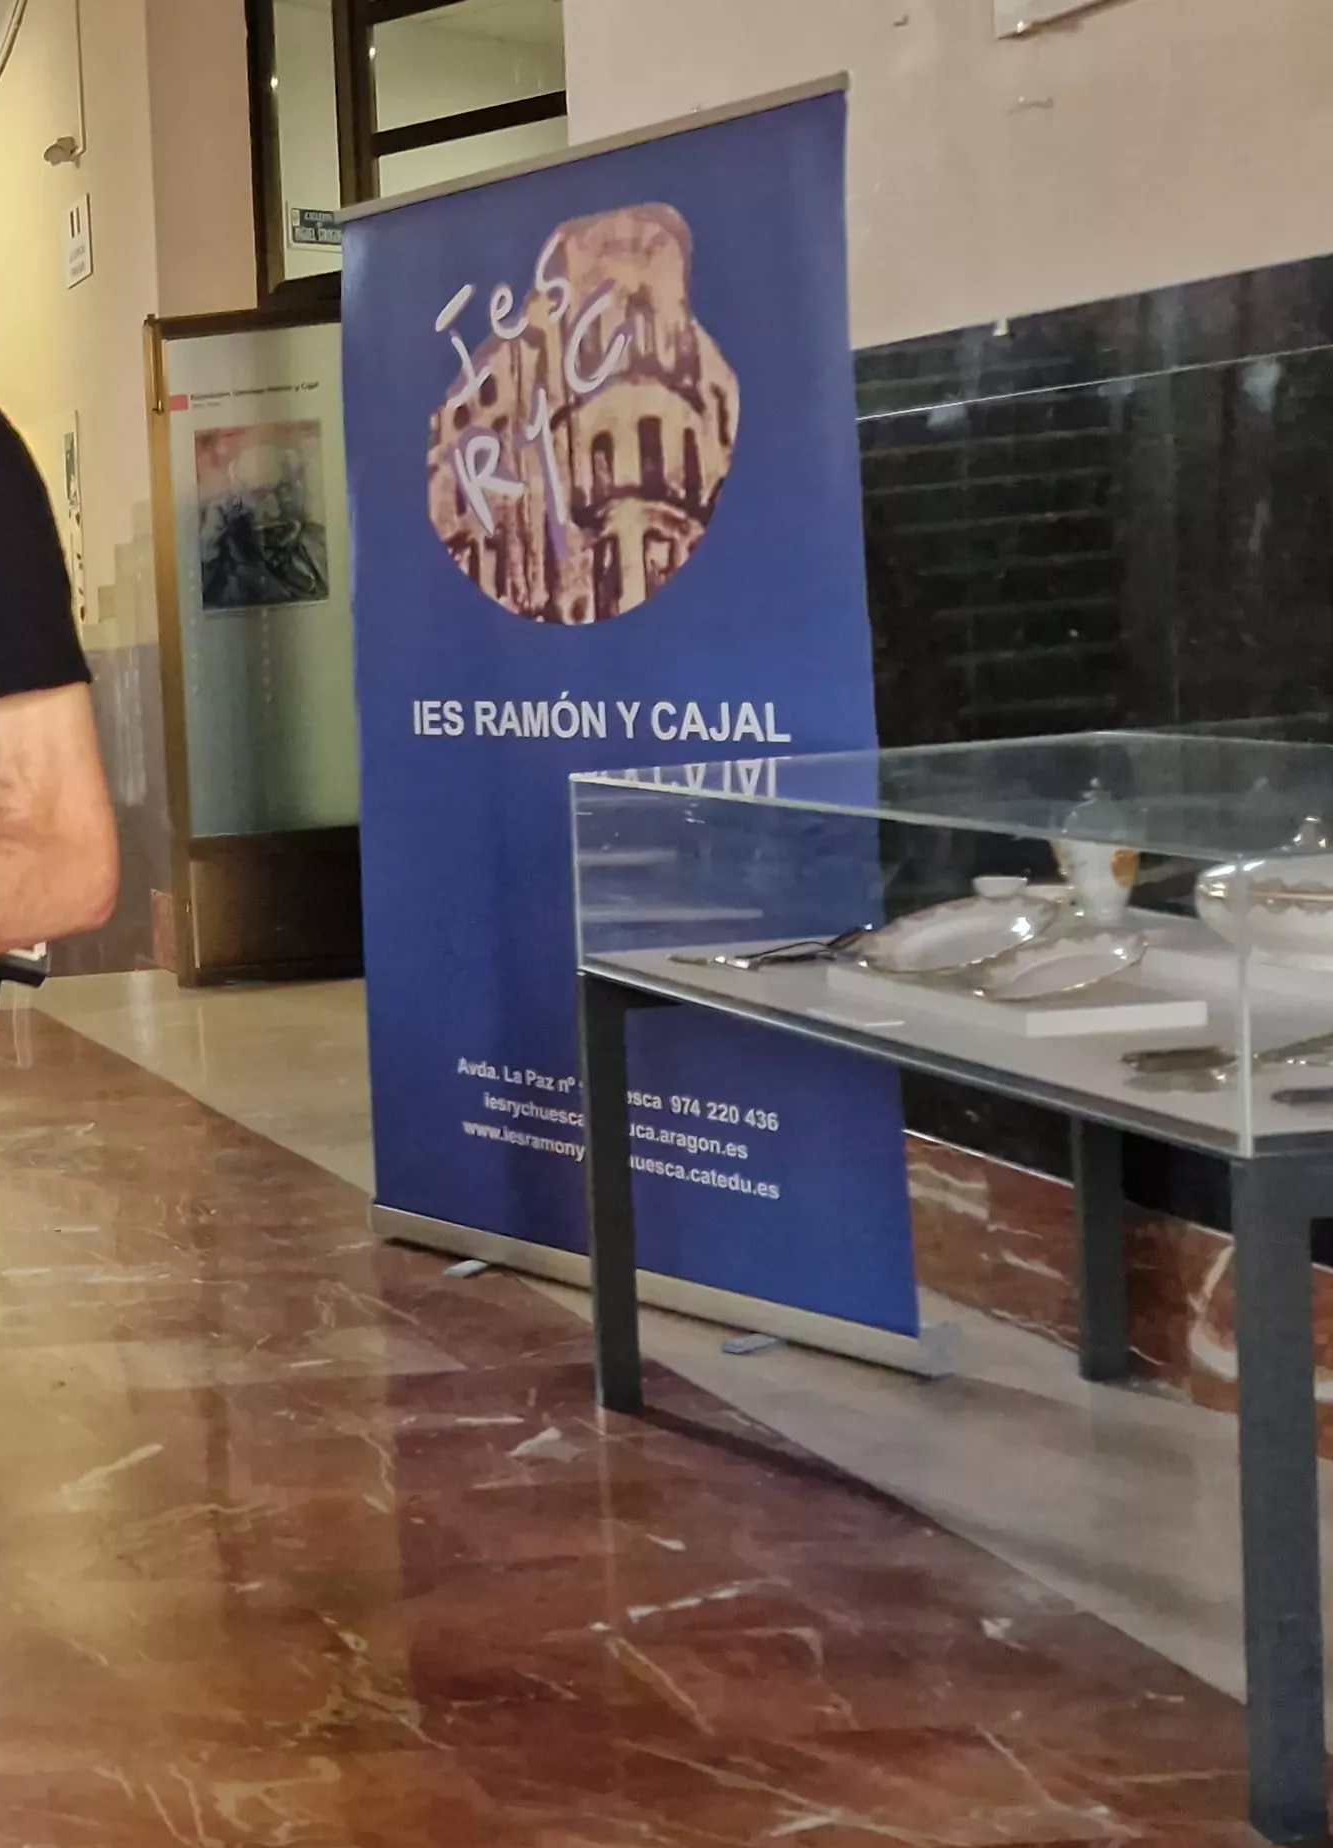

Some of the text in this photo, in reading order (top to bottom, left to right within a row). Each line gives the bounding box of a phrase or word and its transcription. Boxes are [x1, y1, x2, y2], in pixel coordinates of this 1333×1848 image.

[412, 690, 793, 744] IES RAMÓN Y CAJAL
[457, 1056, 500, 1081] Avda.
[503, 1065, 523, 1085] La
[525, 1069, 555, 1092] Paz
[671, 1095, 703, 1118] 974
[706, 1101, 740, 1125] 220
[744, 1108, 780, 1132] 436
